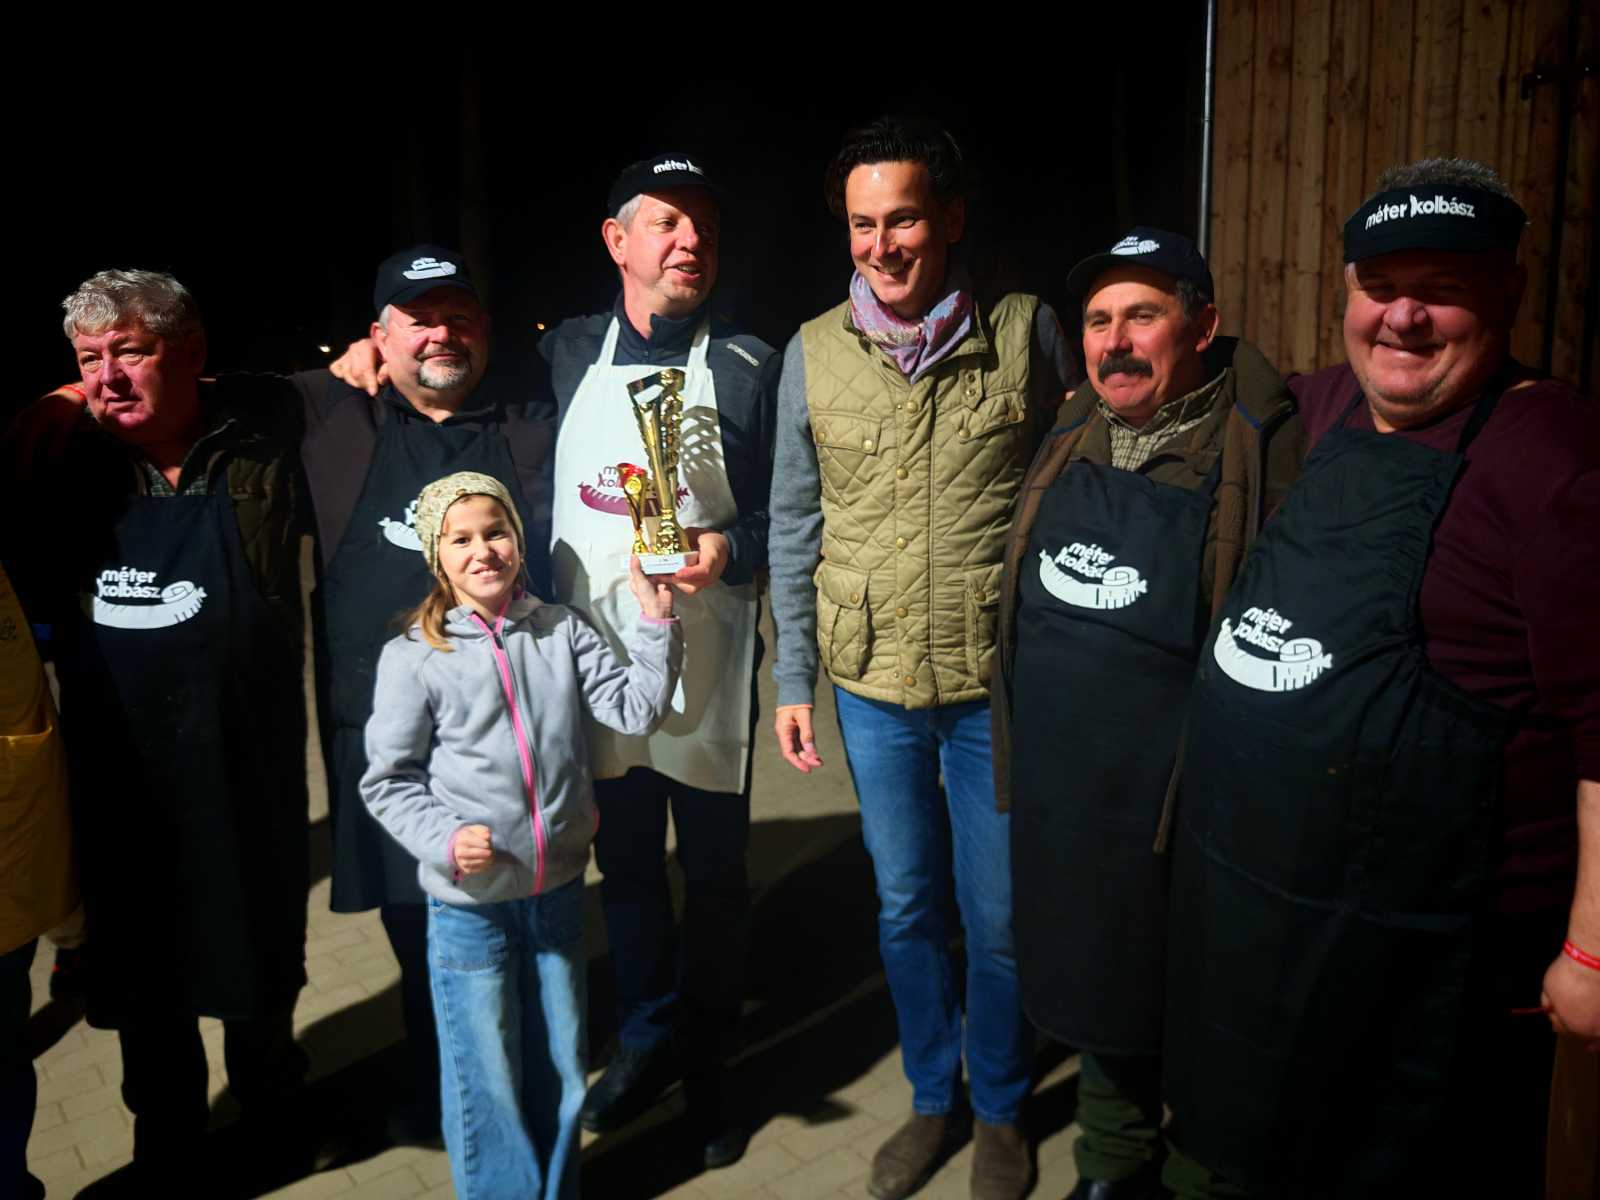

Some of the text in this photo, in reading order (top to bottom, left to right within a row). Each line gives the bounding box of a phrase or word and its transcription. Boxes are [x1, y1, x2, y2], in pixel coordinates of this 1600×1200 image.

[1365, 194, 1476, 230] méter kolbász
[1068, 542, 1116, 566] méter
[102, 566, 157, 583] méter
[96, 577, 161, 598] kolbász
[1242, 606, 1293, 634] méter
